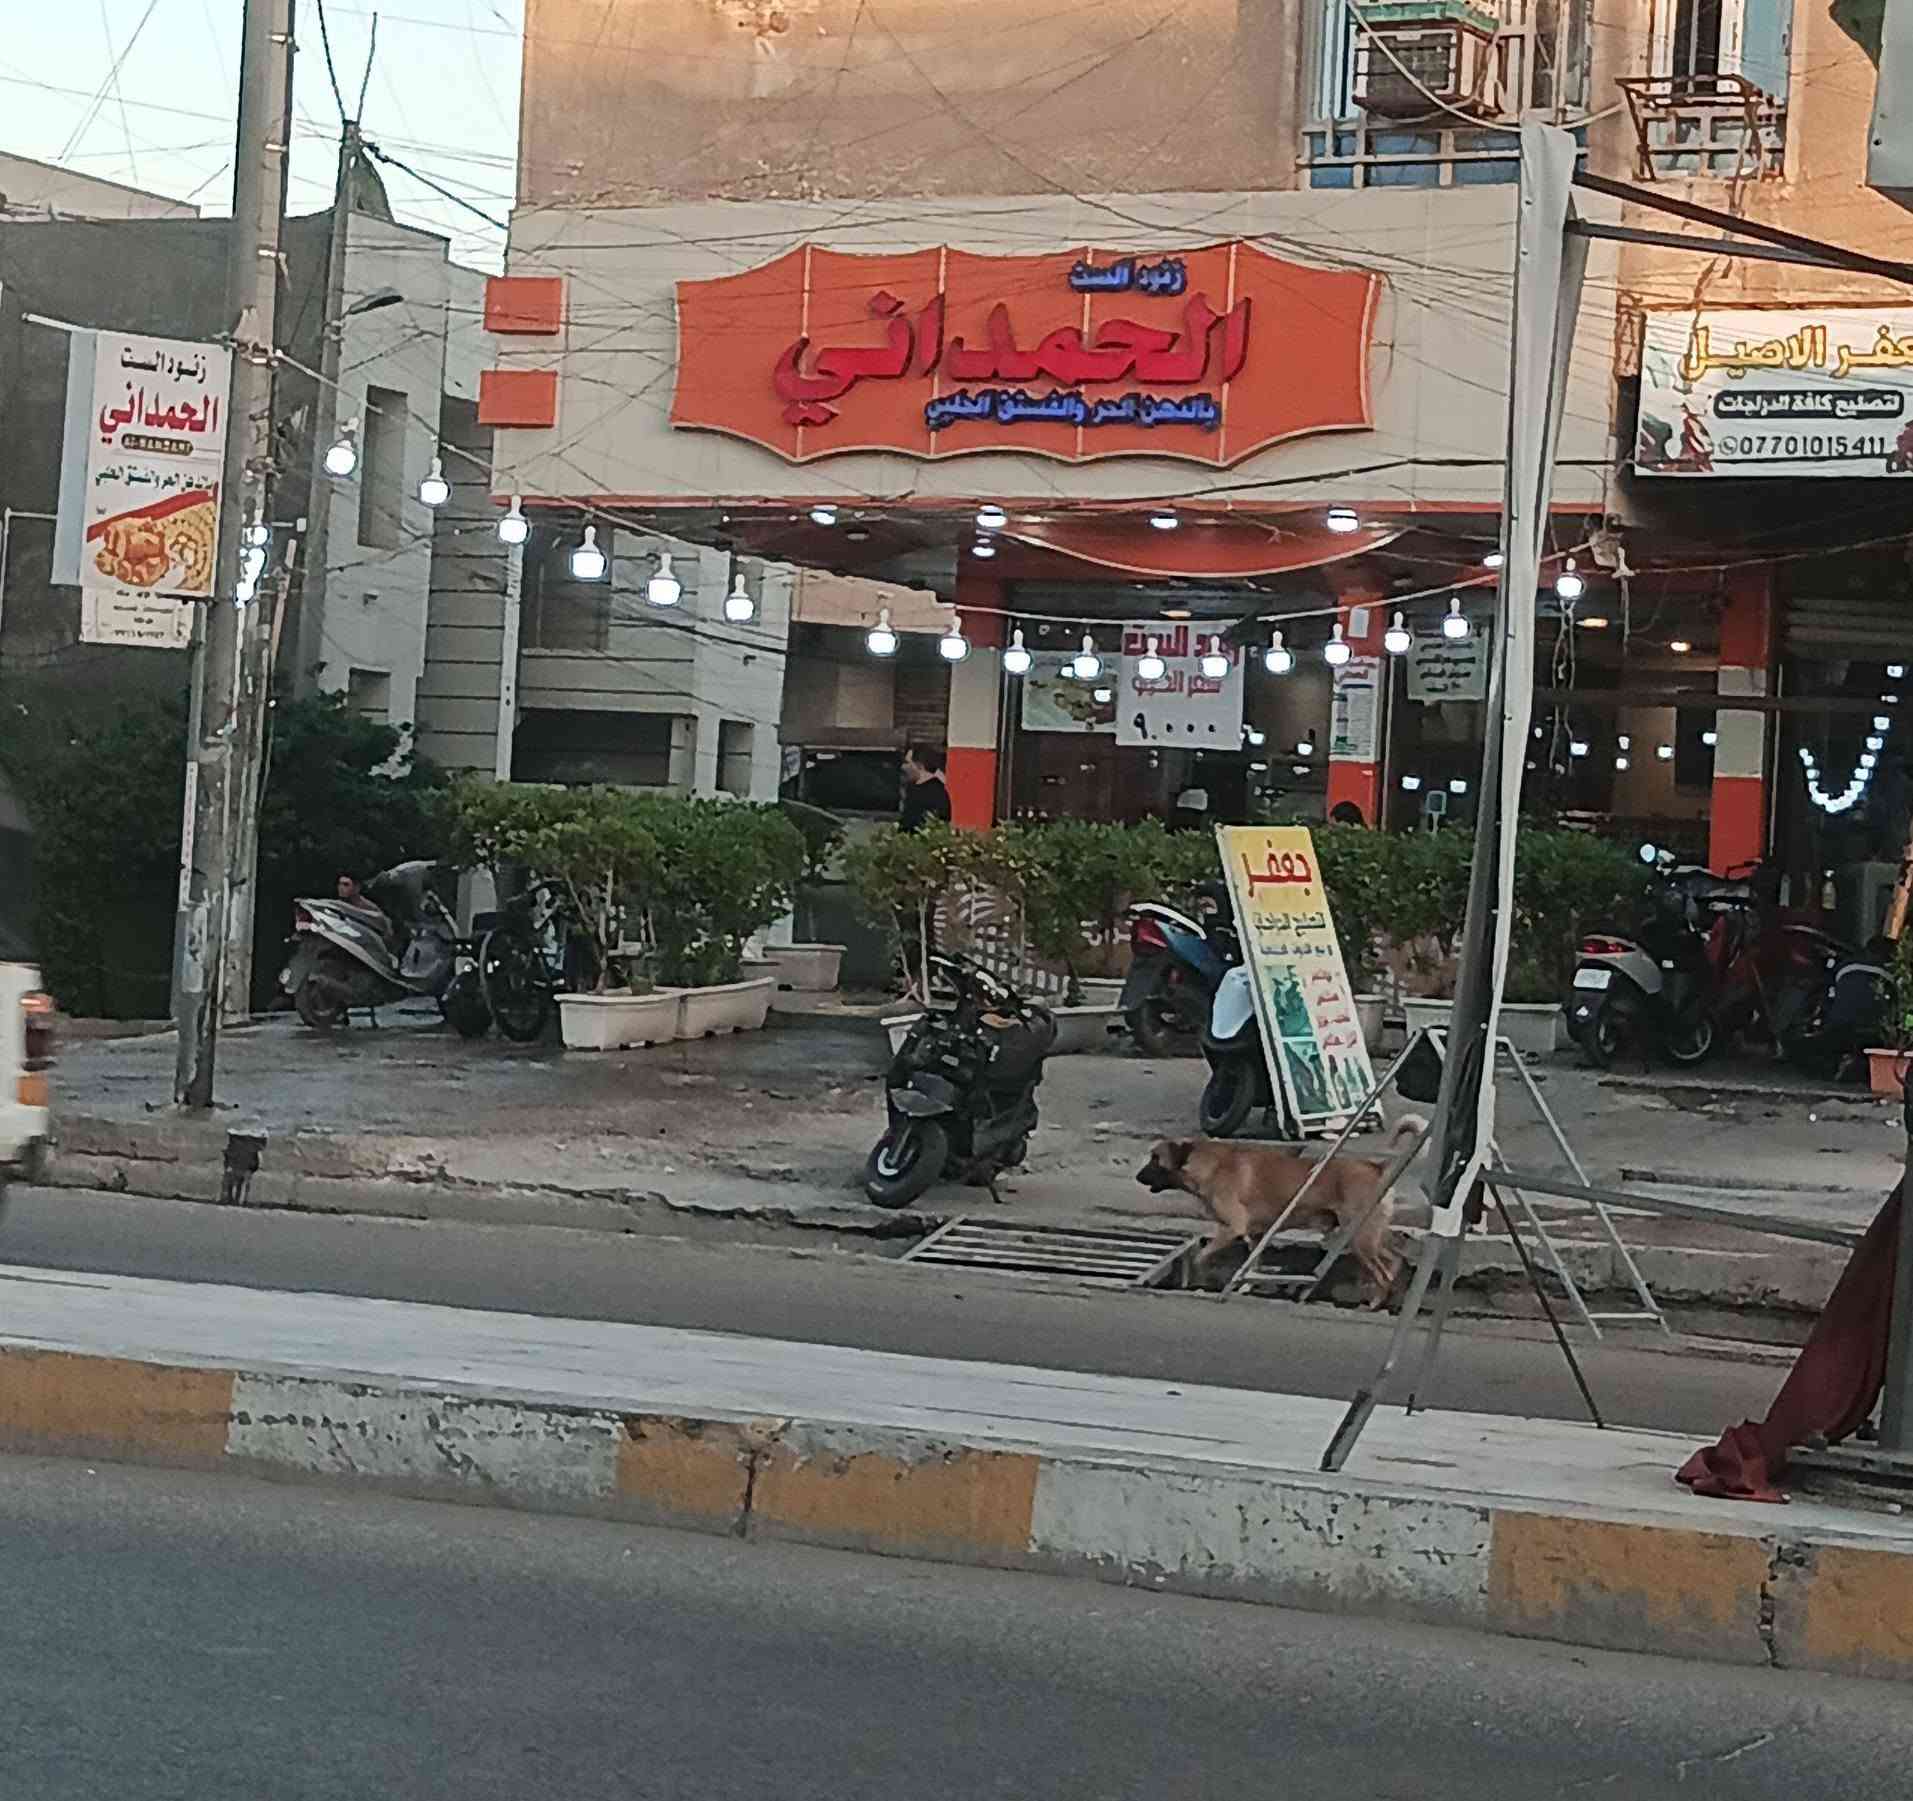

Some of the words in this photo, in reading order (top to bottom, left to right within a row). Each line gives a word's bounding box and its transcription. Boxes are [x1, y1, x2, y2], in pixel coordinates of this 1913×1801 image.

[1069, 259, 1135, 293] الست
[1136, 259, 1186, 294] زنود
[120, 347, 165, 372] الست
[166, 352, 206, 384] زنود
[775, 291, 1251, 427] الحمداني
[1680, 324, 1827, 382] الاصيل
[1829, 324, 1913, 380] عفر
[99, 380, 220, 445] الحمداني
[926, 390, 997, 431] الحلبي
[998, 390, 1089, 426] والفستق
[1792, 391, 1834, 412] كافة
[1739, 435, 1886, 456] 07701015411
[1241, 840, 1312, 897] جعفر
